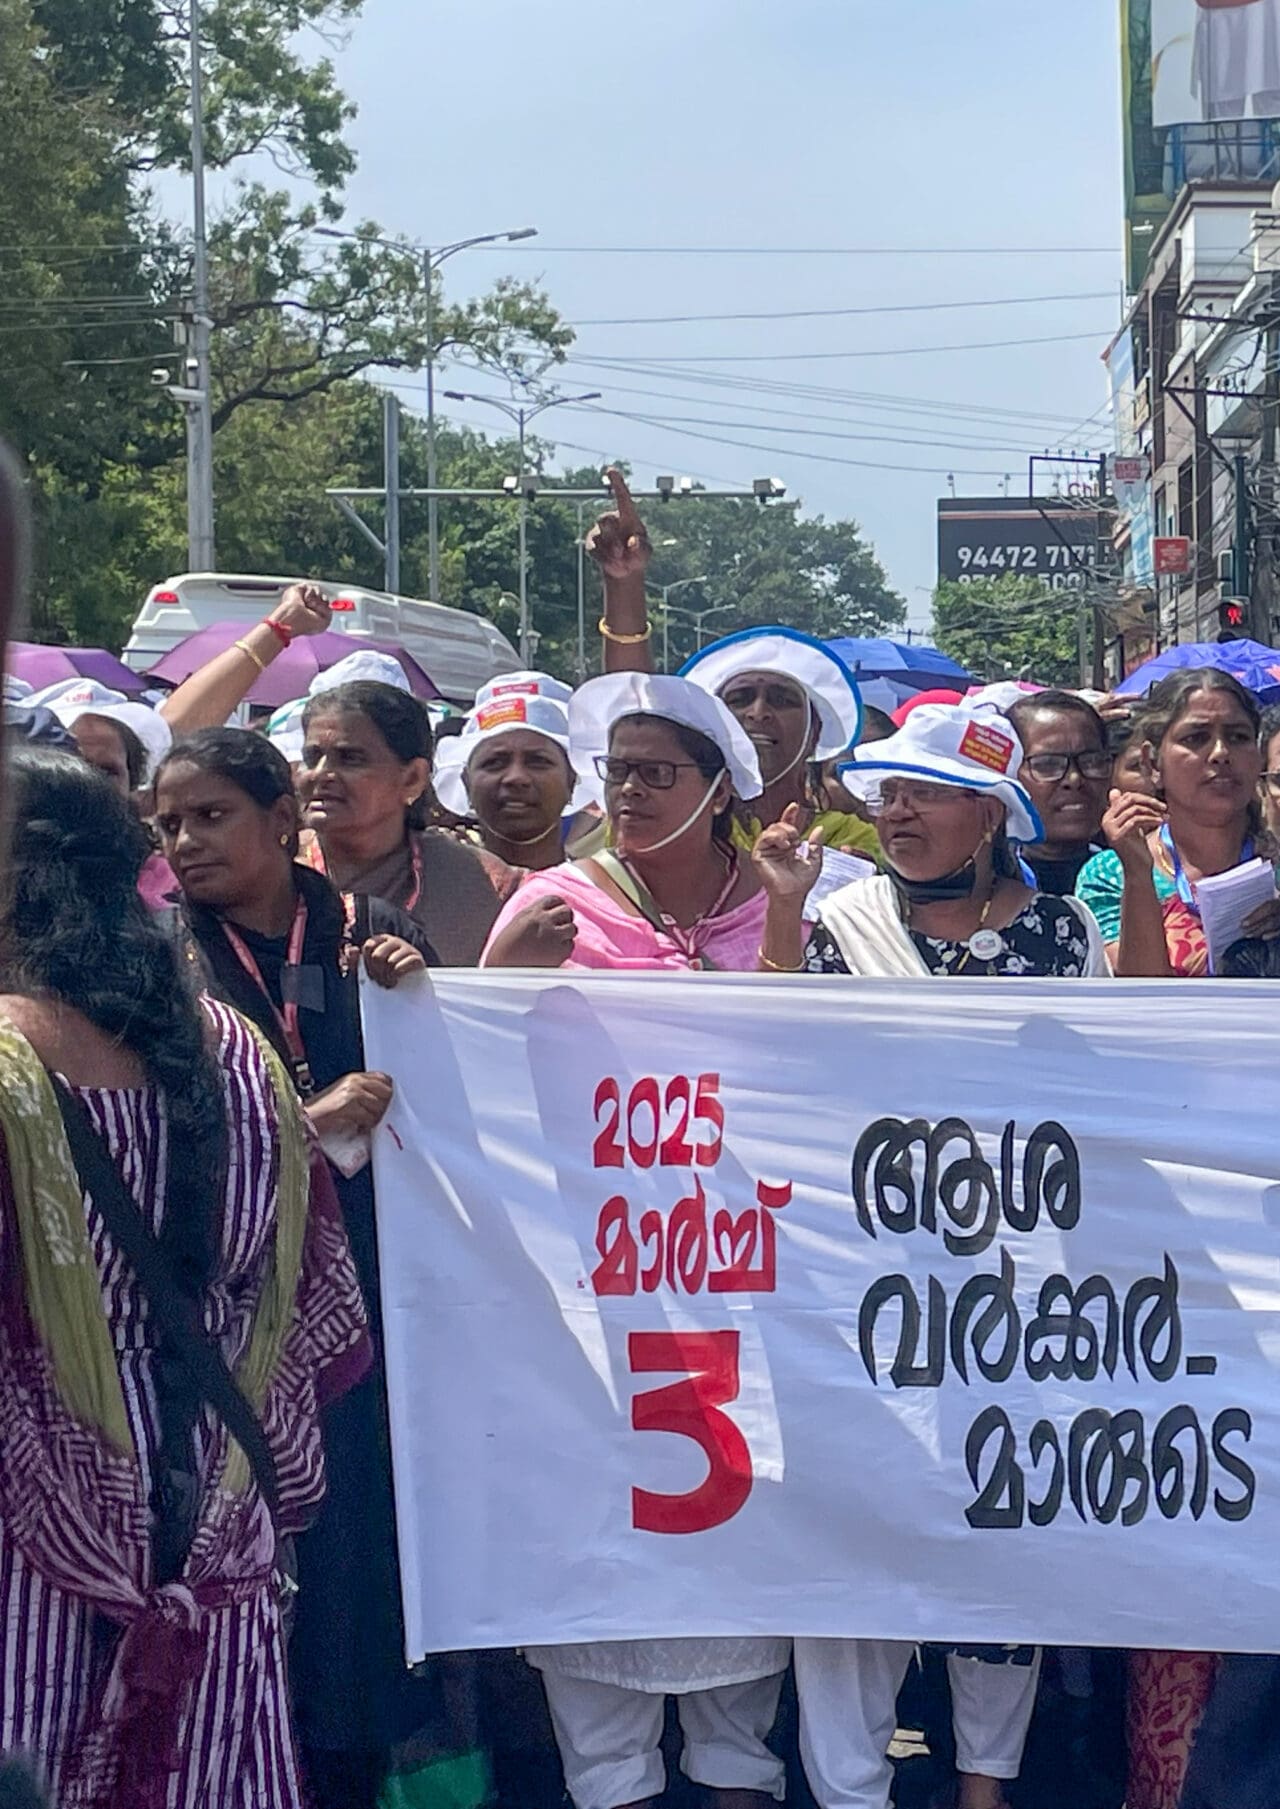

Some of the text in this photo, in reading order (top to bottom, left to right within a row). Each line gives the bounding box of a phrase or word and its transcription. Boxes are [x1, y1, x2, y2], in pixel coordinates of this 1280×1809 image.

[957, 546, 1037, 568] 94472
[592, 1074, 724, 1168] 2025
[591, 1173, 793, 1297] മാർച്ച്
[851, 1116, 1082, 1257] ആശ
[628, 1329, 753, 1534] 3
[963, 1404, 1256, 1529] മാരുടെ
